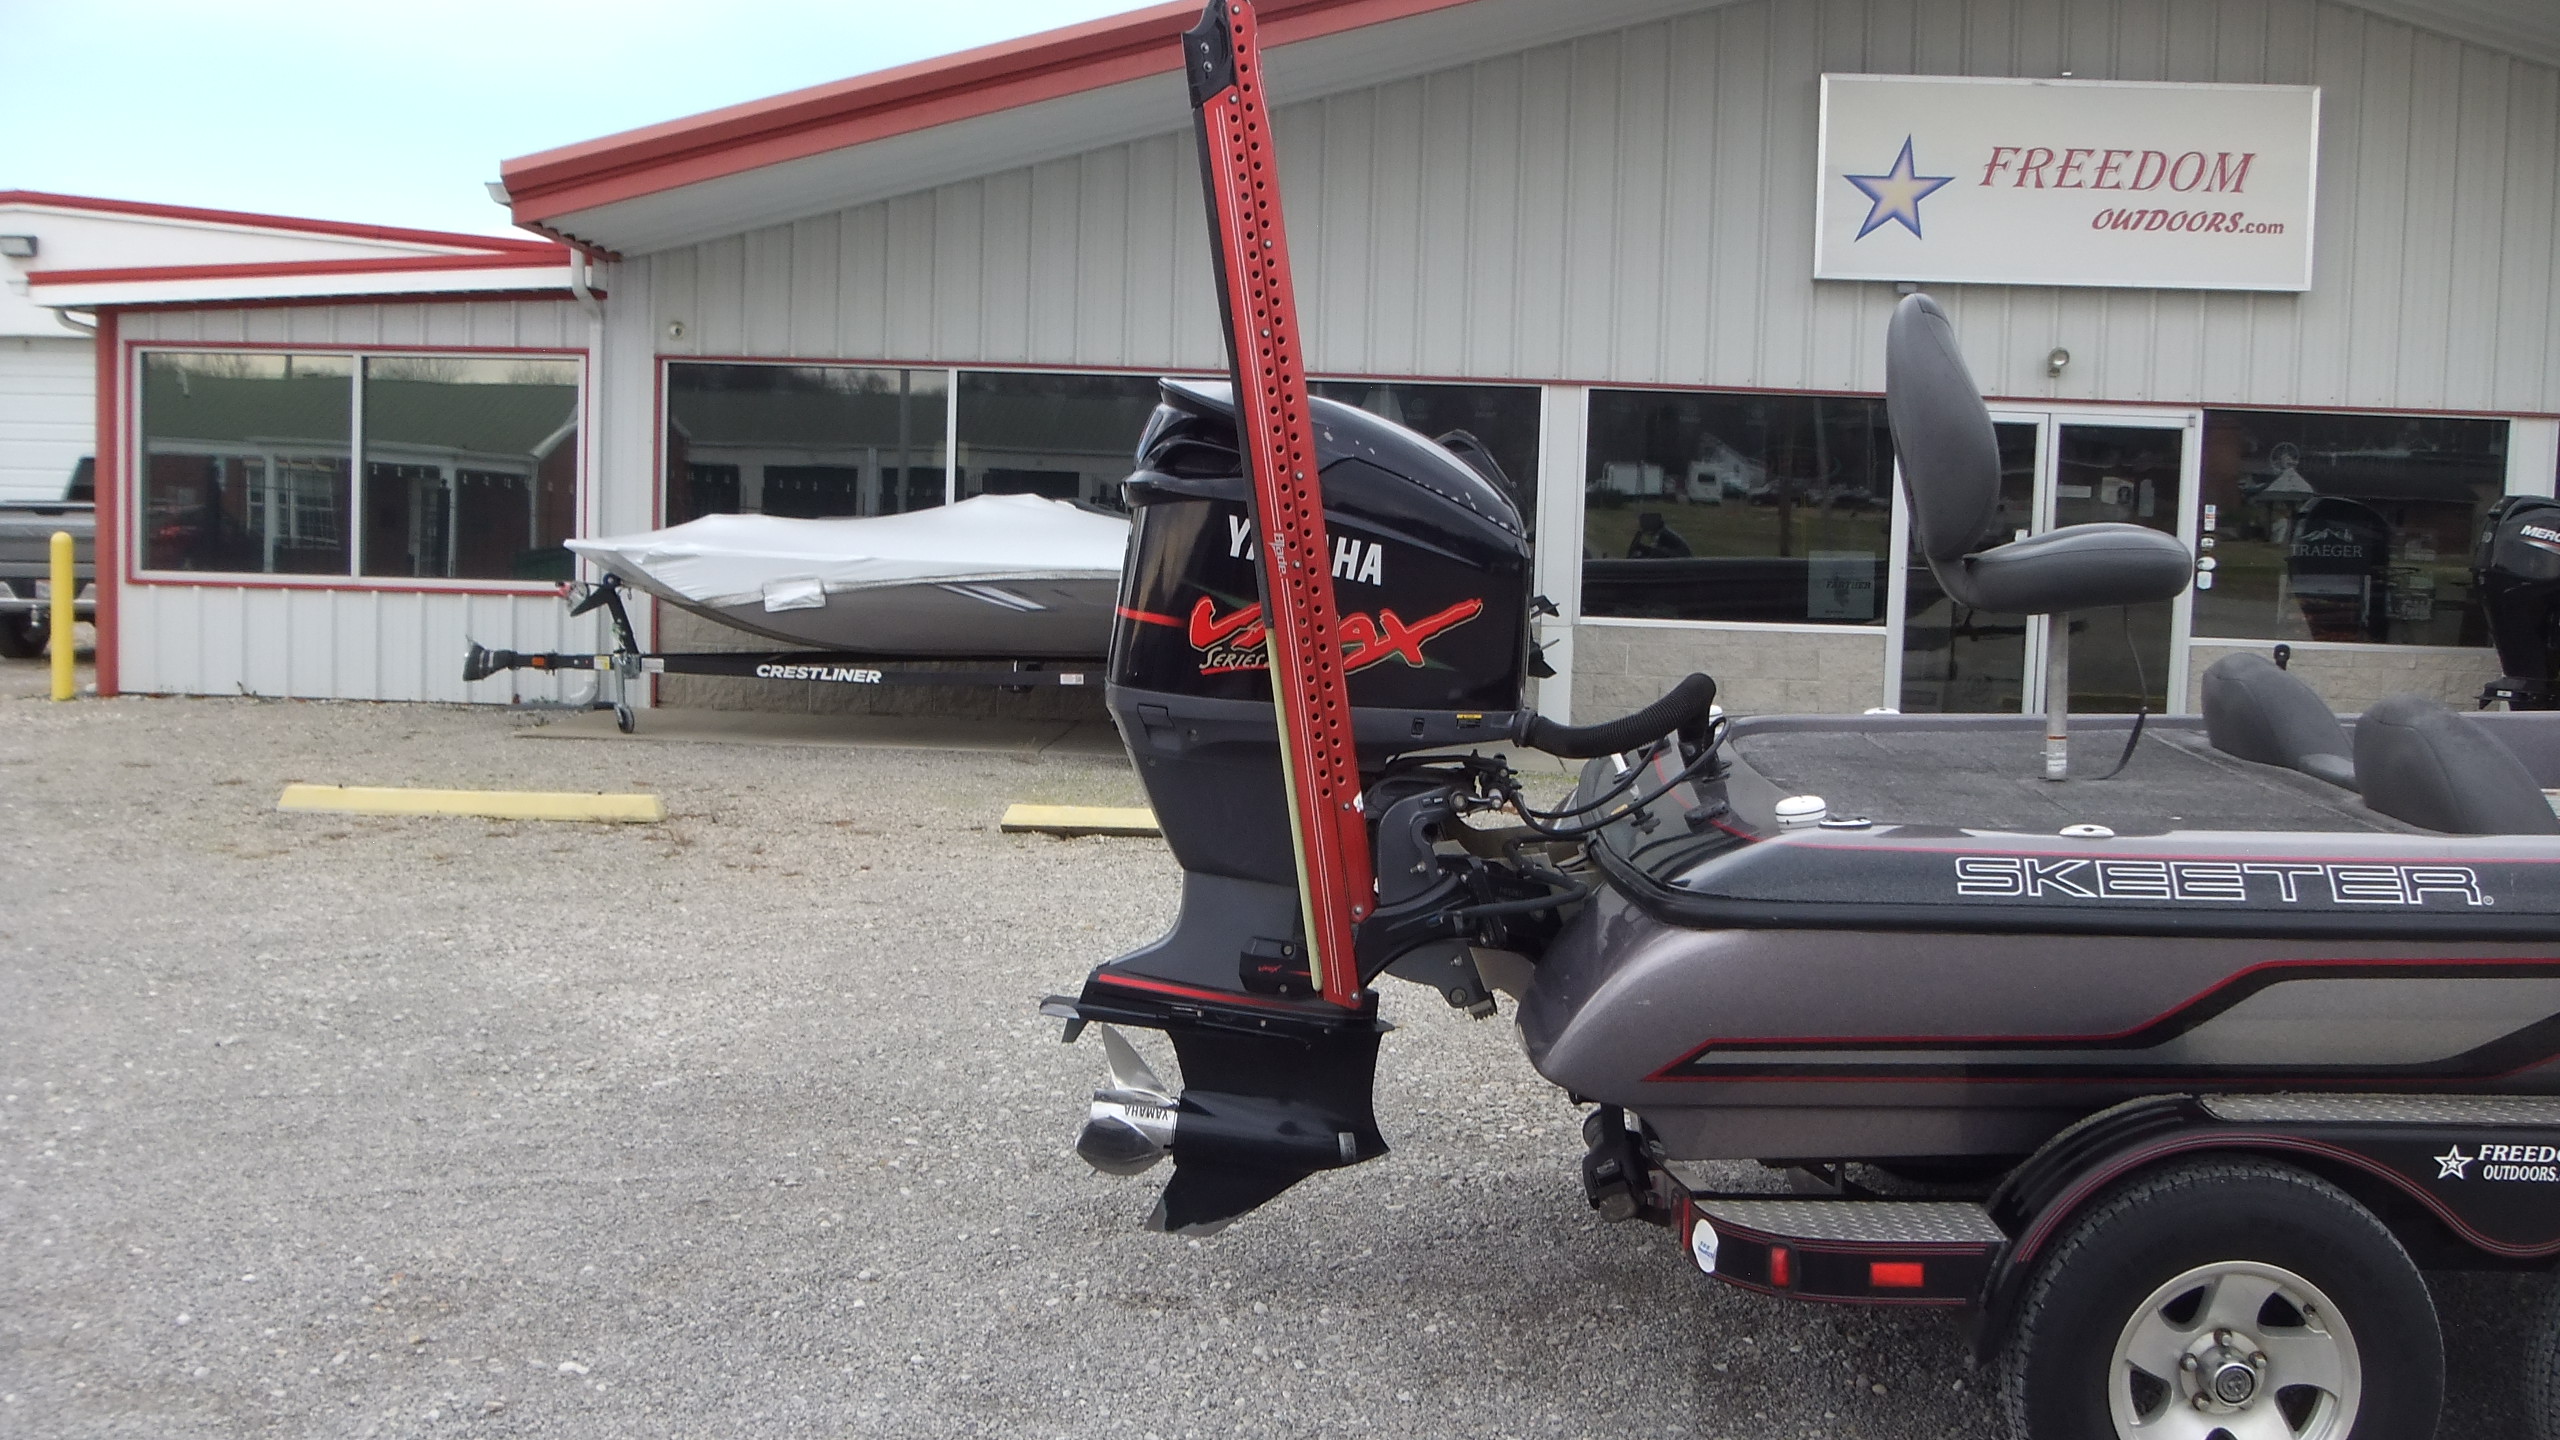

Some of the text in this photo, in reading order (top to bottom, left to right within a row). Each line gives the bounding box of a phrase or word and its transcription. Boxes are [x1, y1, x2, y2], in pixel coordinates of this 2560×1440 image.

[1979, 146, 2255, 193] FREEDOM
[2091, 208, 2284, 235] OUTDOORS.com
[2289, 544, 2362, 557] TRAEGER
[756, 664, 882, 684] CRESTLINER
[1955, 858, 2482, 906] SKEETER
[1124, 1103, 1169, 1121] YAMAHA
